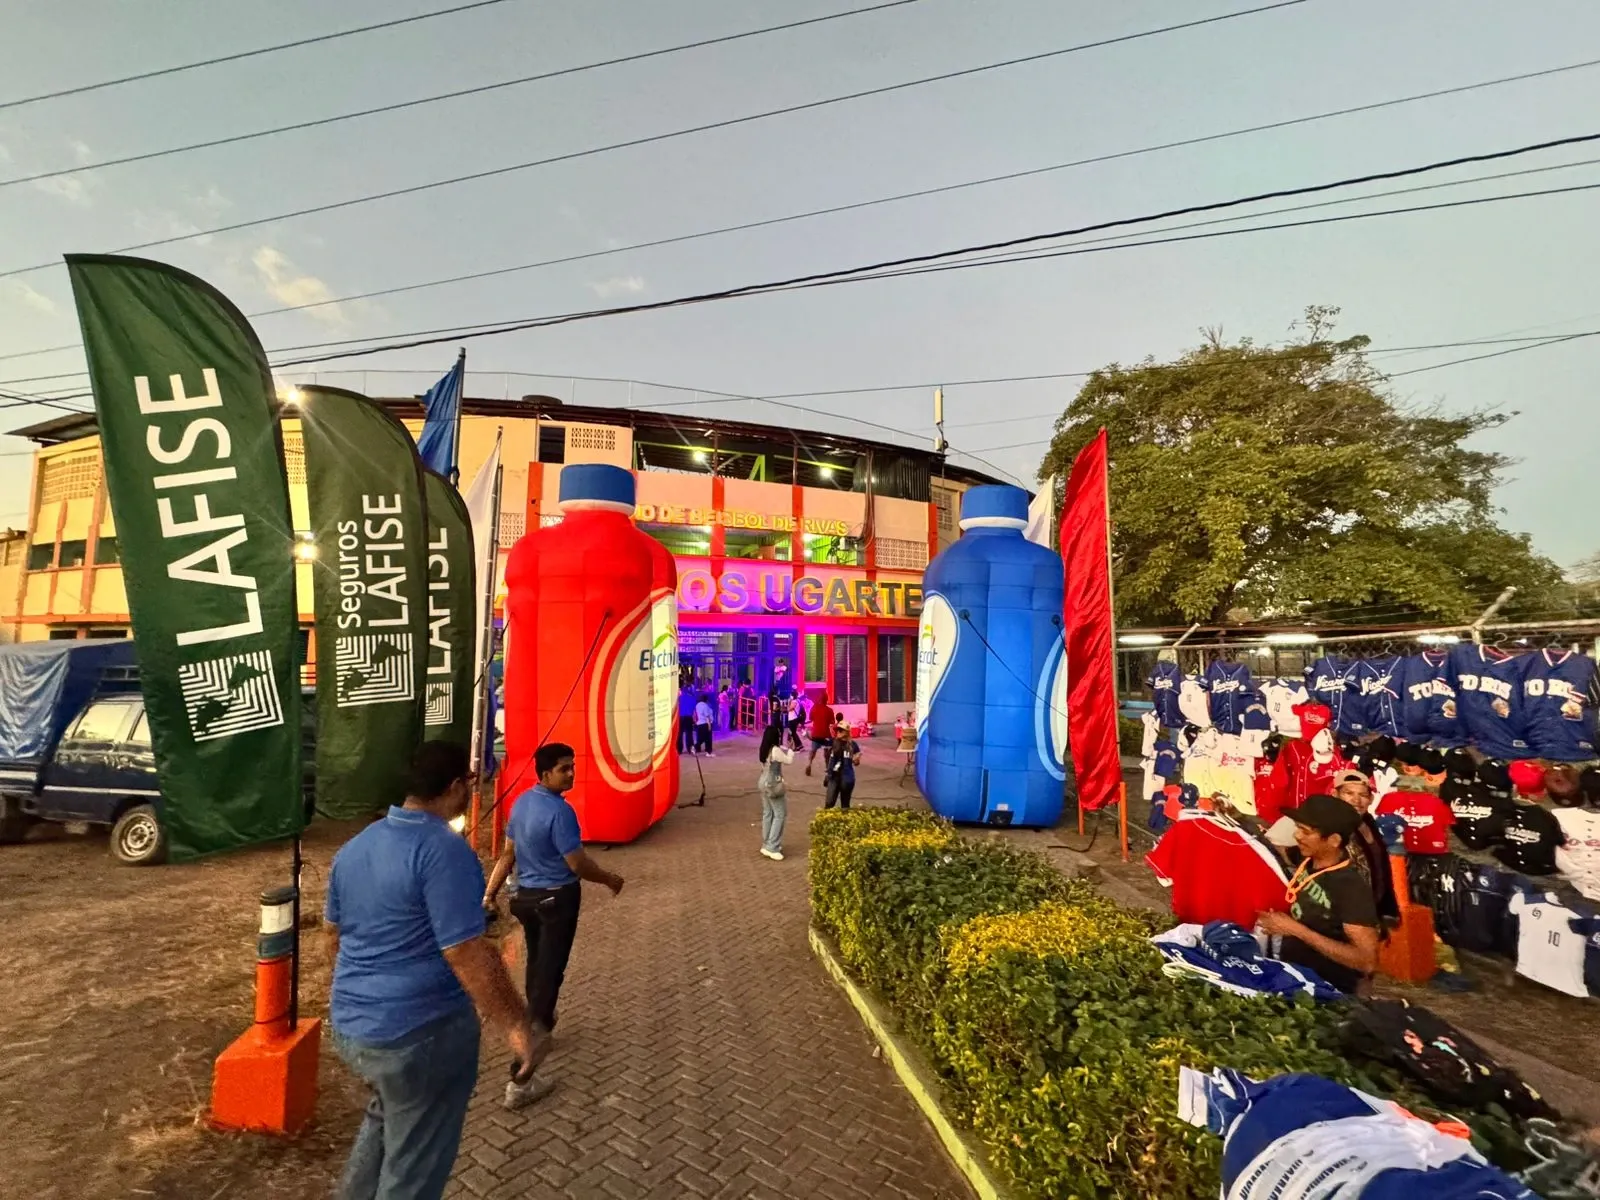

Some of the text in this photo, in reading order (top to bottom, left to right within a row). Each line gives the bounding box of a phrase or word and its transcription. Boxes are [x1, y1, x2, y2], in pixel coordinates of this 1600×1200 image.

[134, 367, 264, 647] LAFISE
[803, 518, 849, 537] RIVAS
[337, 520, 366, 629] Seguros
[361, 493, 410, 628] LAFISE
[679, 569, 923, 616] OS UGARTE
[1547, 929, 1561, 948] 10
